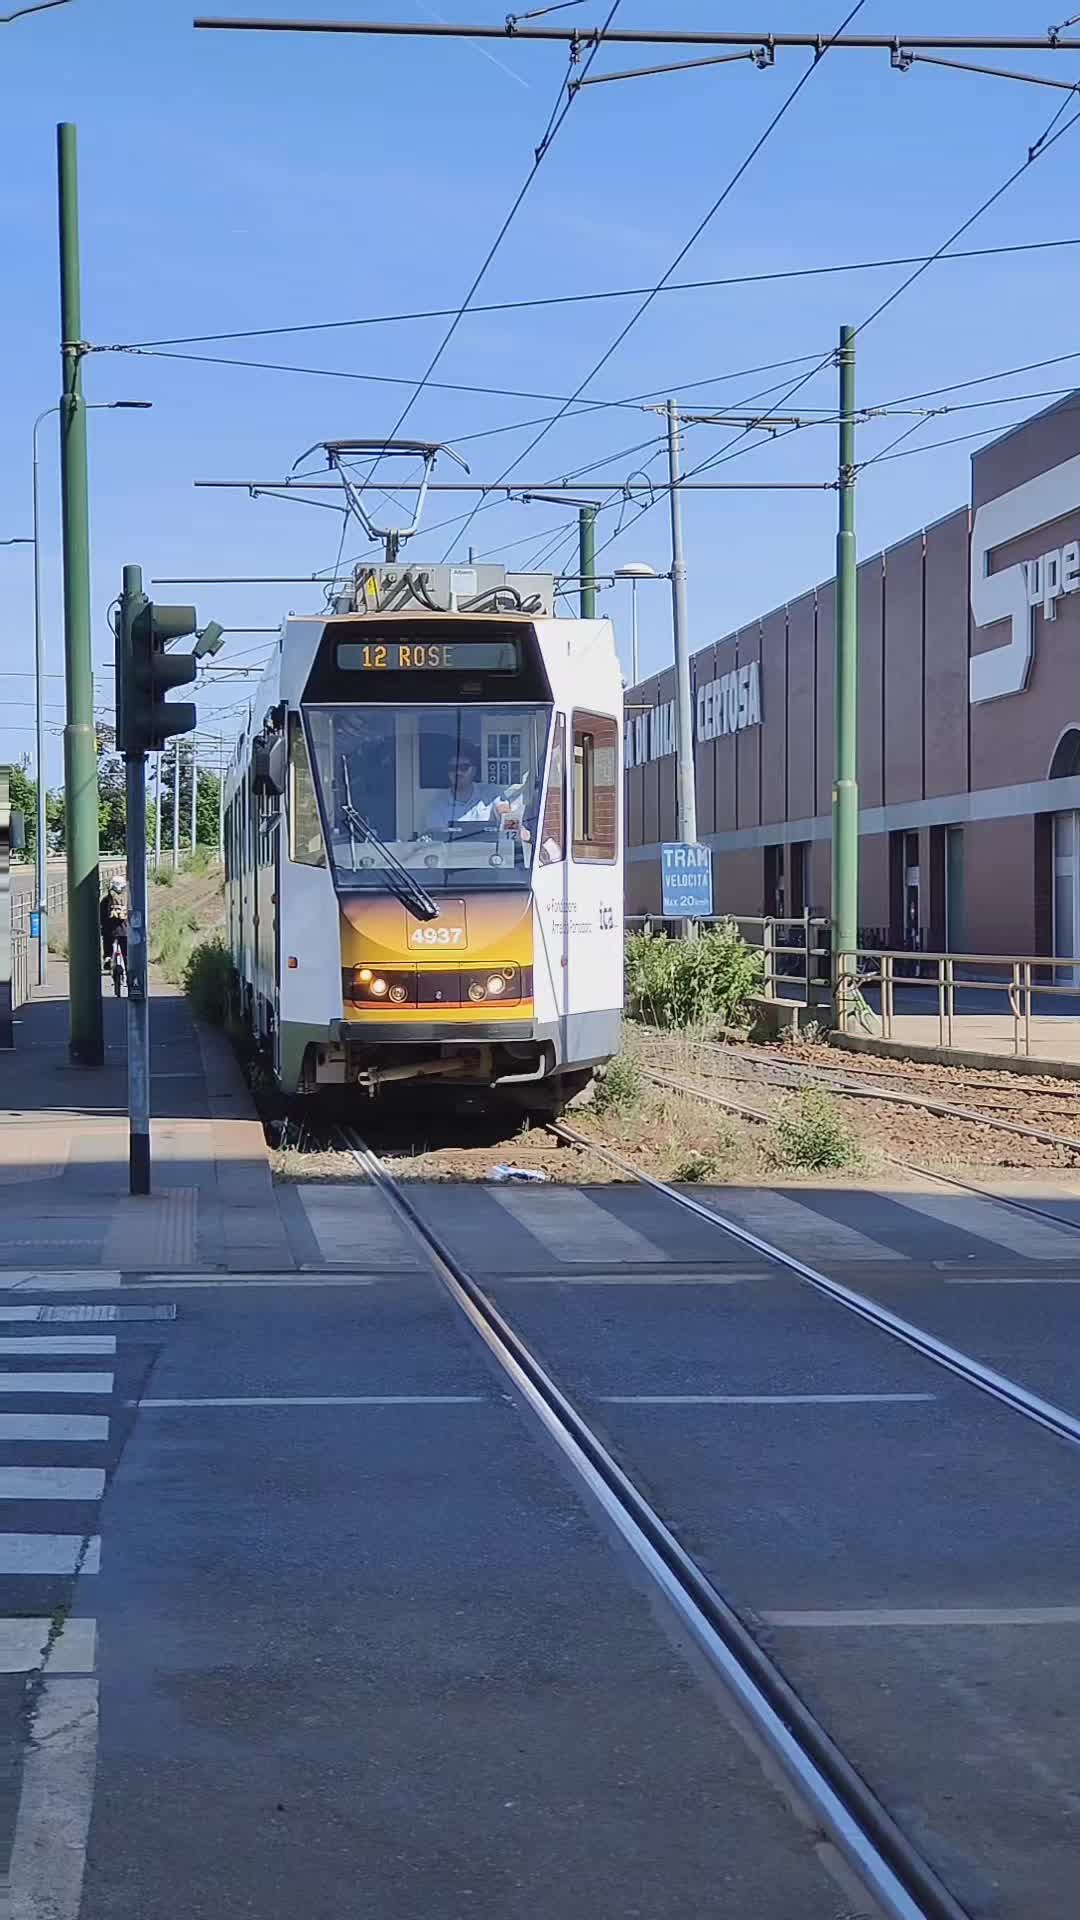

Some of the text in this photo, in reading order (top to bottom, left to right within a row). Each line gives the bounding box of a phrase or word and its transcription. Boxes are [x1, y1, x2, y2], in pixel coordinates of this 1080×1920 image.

[362, 646, 387, 667] 12
[697, 659, 761, 742] CERTOSA
[663, 848, 708, 867] TRAM
[680, 896, 694, 906] 20
[411, 928, 462, 944] 4937
